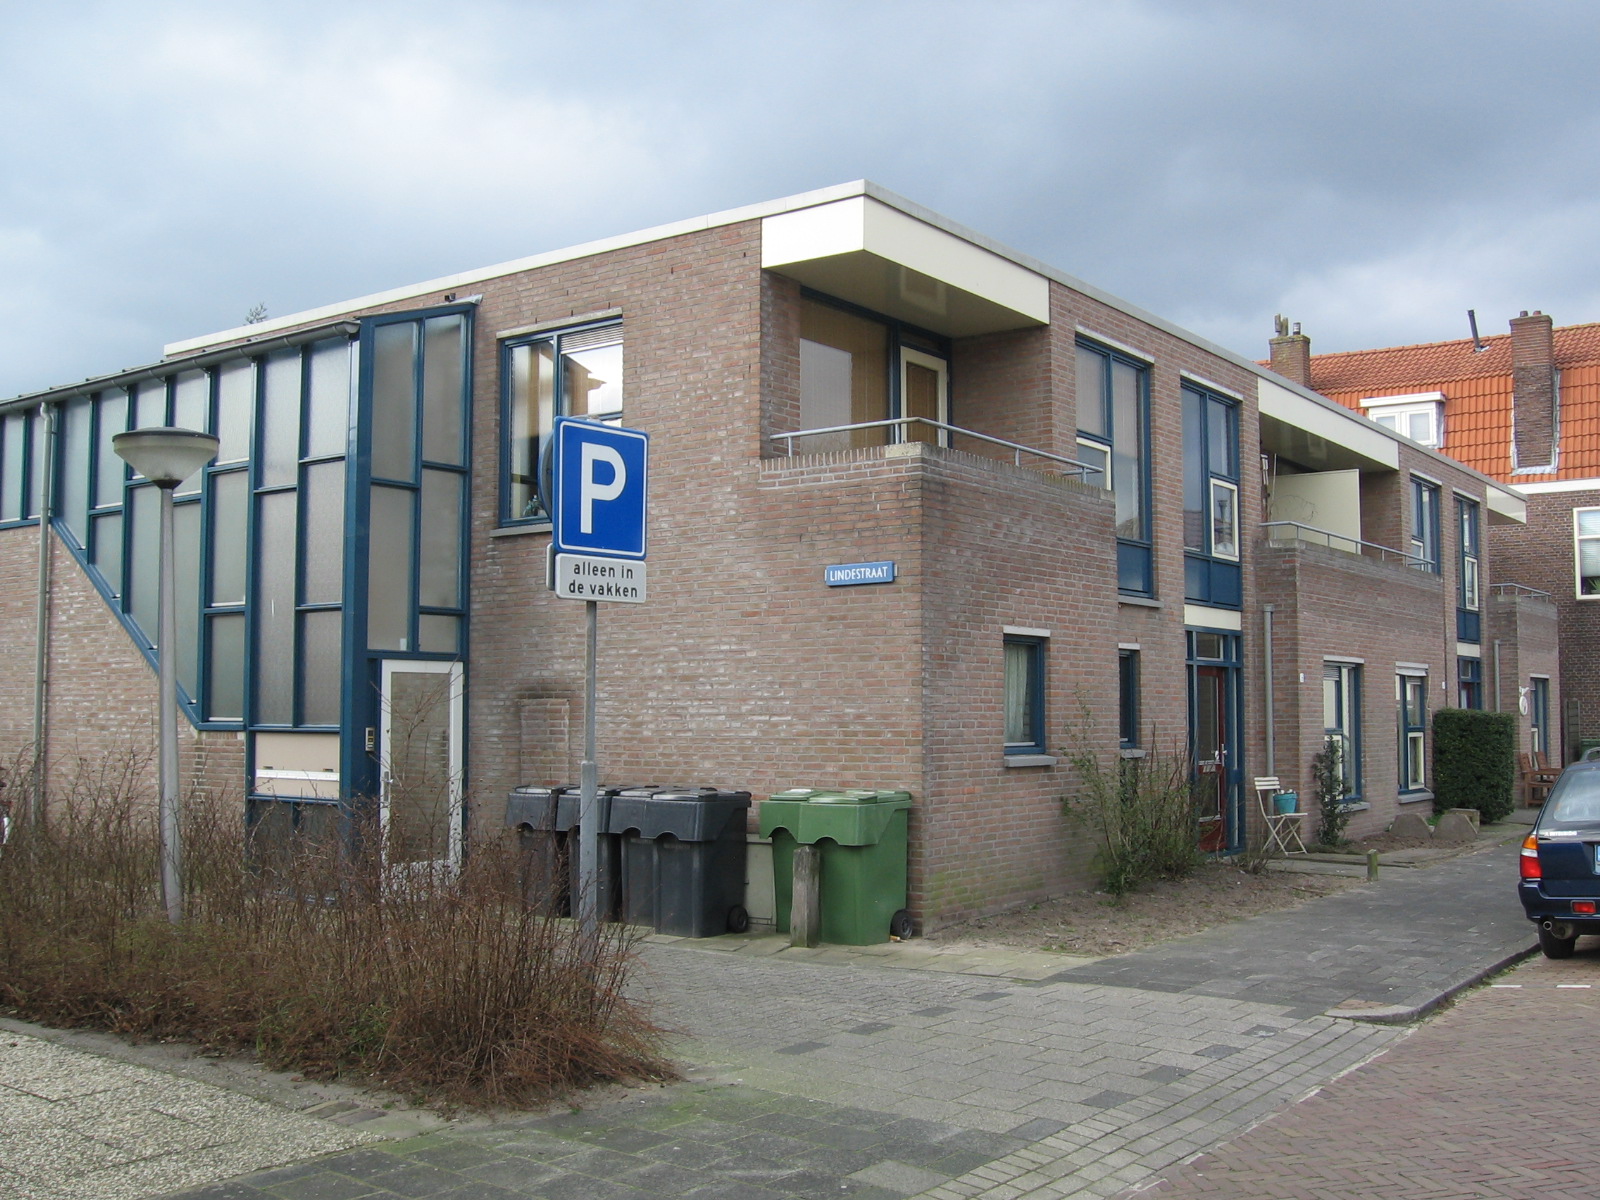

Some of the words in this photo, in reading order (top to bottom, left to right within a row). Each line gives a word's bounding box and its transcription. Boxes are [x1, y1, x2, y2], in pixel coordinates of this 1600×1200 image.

[580, 441, 626, 534] P
[573, 561, 615, 578] alleen
[621, 565, 633, 579] in
[829, 566, 888, 581] LINDESTRAAT
[568, 579, 584, 594] de
[589, 582, 638, 598] vakken
